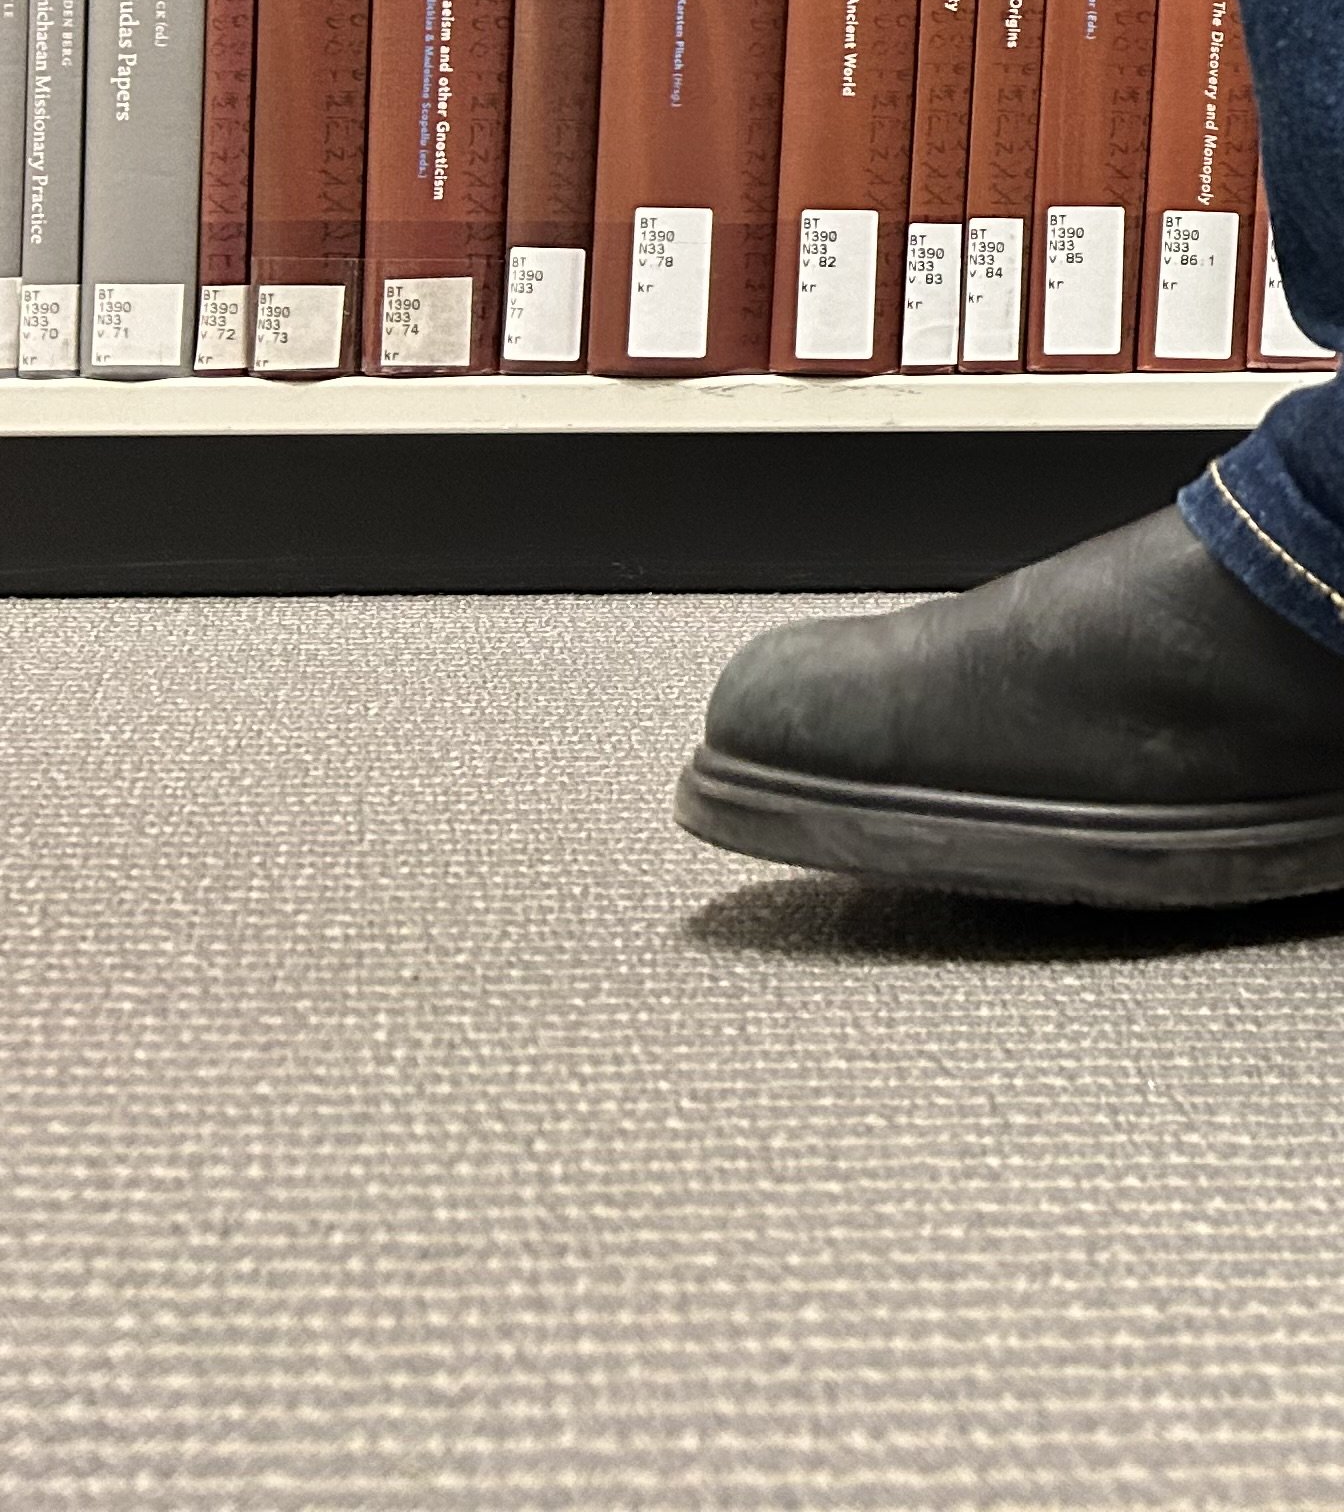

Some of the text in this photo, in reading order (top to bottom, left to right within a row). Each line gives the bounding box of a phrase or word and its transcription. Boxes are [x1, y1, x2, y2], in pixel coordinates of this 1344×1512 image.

[111, 54, 137, 120] Papers
[28, 76, 51, 170] Missionary
[31, 175, 48, 244] Practice
[641, 218, 657, 229] BT
[642, 231, 675, 242] 1390
[639, 243, 664, 254] N33
[513, 257, 526, 267] BT
[512, 270, 543, 282] 1390
[511, 283, 533, 293] N33
[638, 282, 653, 292] kr
[511, 307, 523, 318] 77
